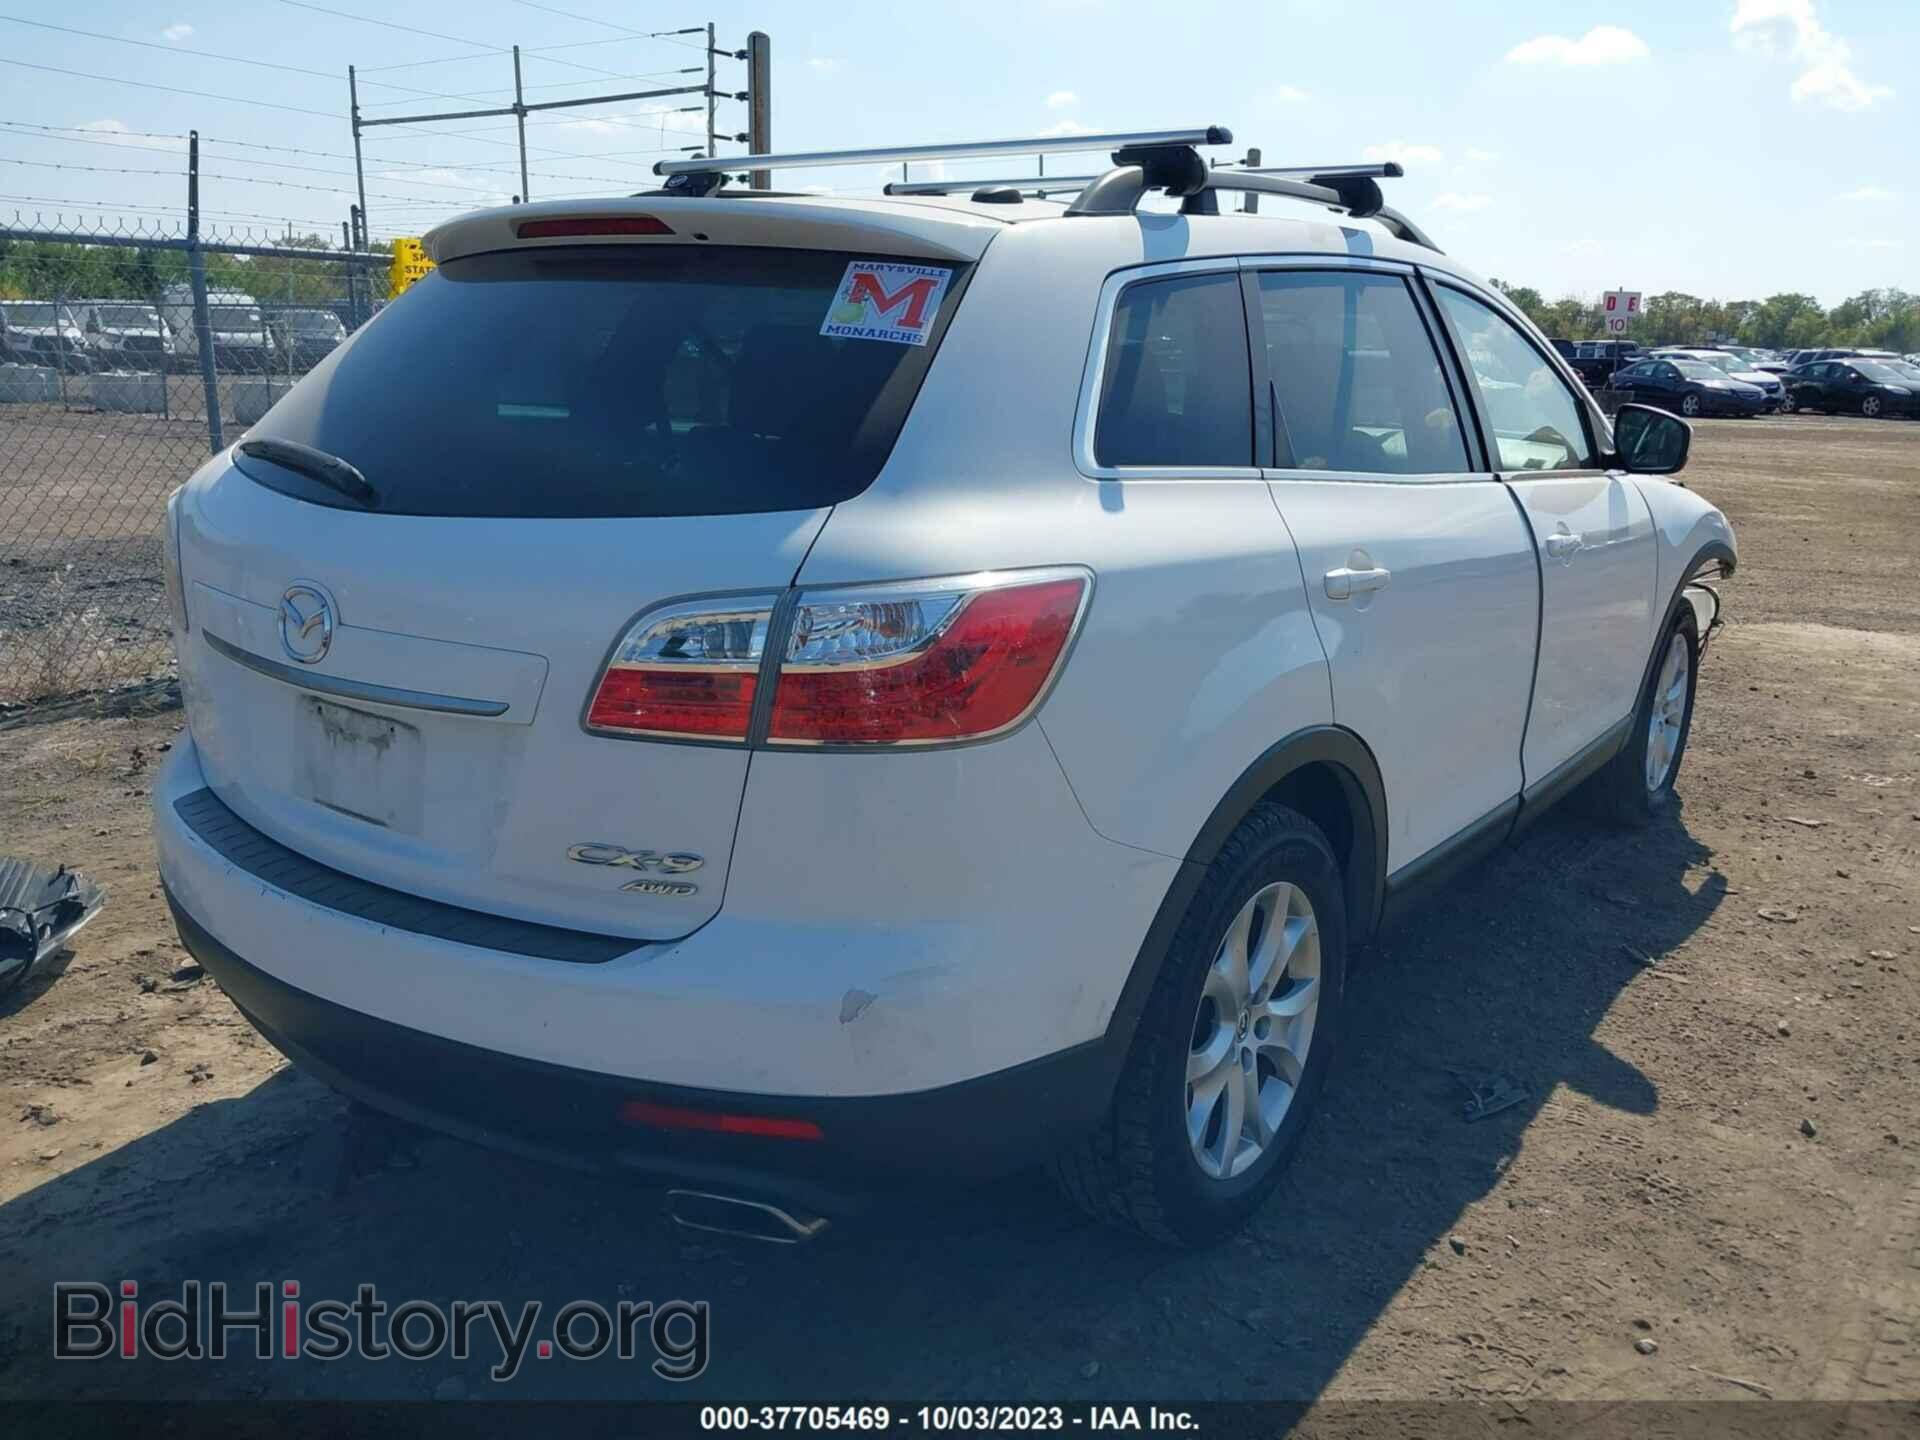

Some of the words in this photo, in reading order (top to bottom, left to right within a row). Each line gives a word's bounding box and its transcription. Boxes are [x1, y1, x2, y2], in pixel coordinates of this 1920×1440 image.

[853, 263, 949, 277] MARYSVILLE
[847, 272, 940, 329] M
[1627, 296, 1637, 312] E
[1609, 318, 1625, 332] 10
[826, 325, 924, 344] MONARCHS
[567, 842, 705, 874] CX-9
[620, 879, 698, 896] AWD
